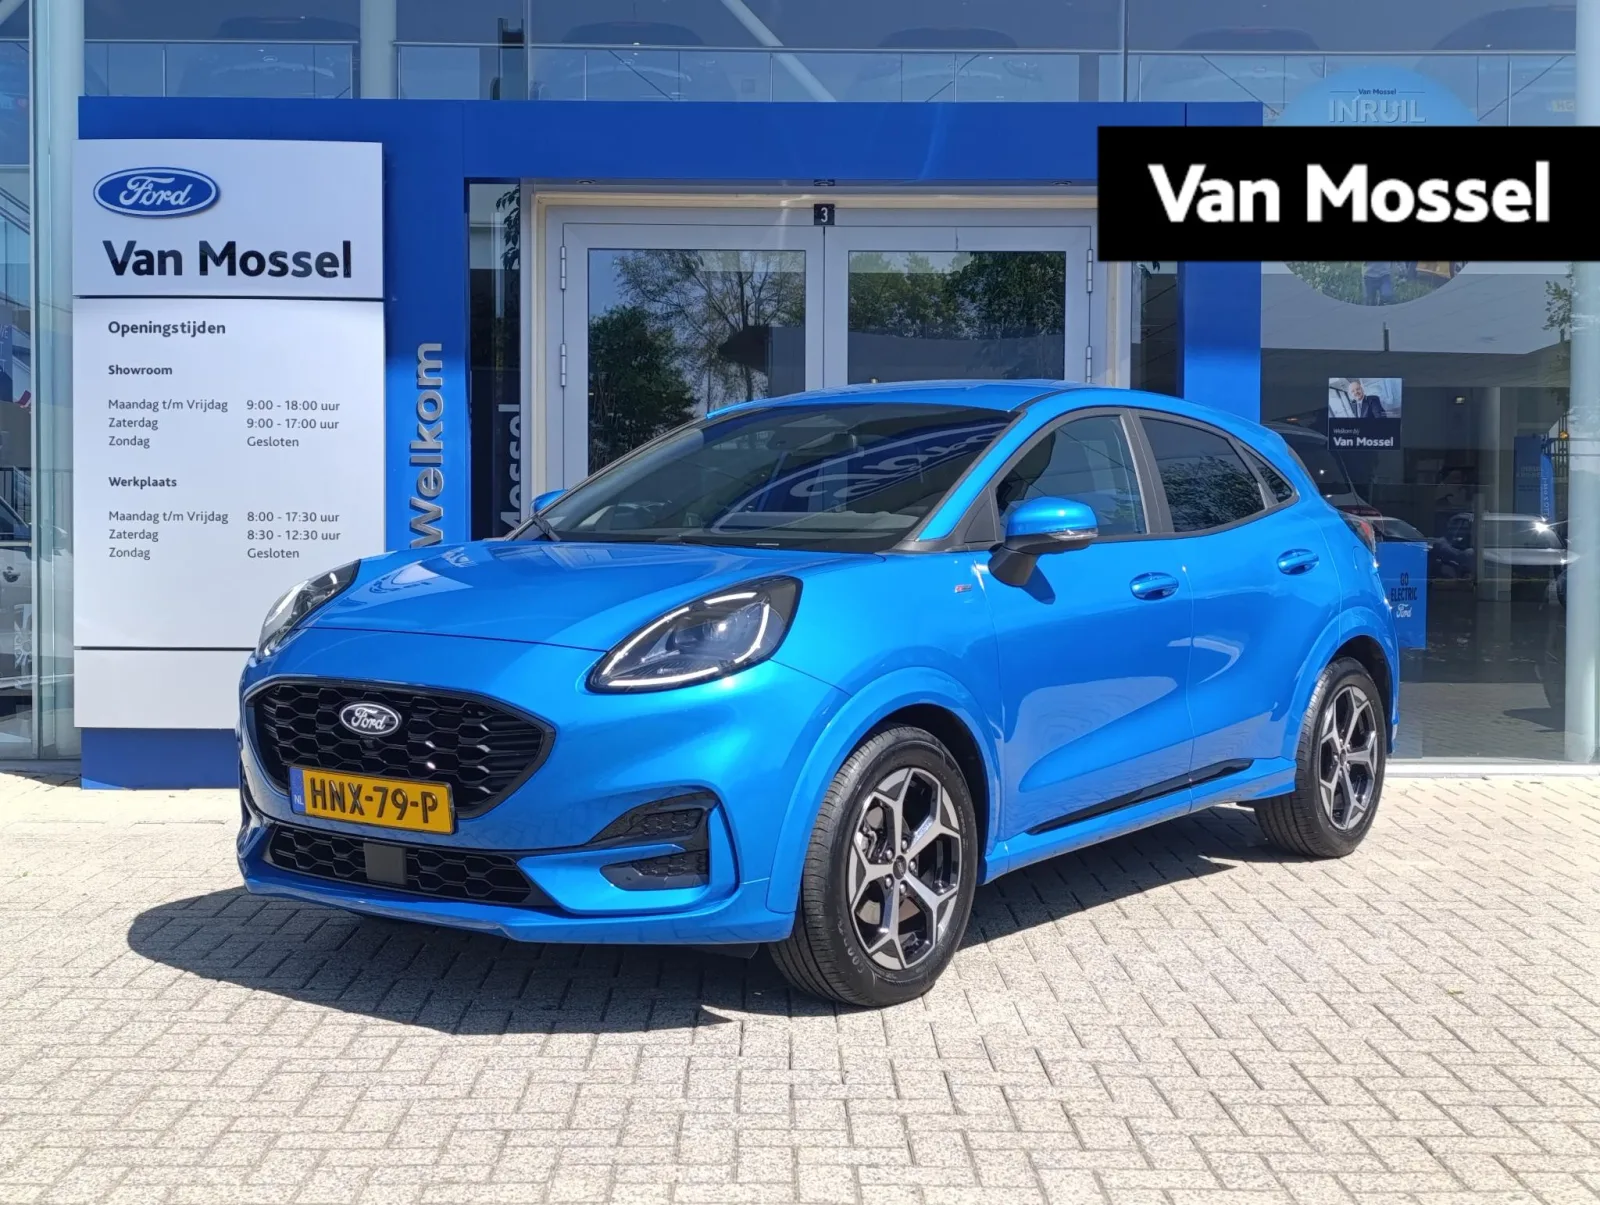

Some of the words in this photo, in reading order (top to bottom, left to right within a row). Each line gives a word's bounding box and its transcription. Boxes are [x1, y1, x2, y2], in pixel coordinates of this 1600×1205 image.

[1358, 88, 1371, 96] Van
[1372, 88, 1397, 96] Mossel
[1328, 98, 1427, 123] INRUIL
[119, 176, 192, 207] Ford
[821, 206, 829, 223] 3
[102, 240, 183, 277] Van
[199, 240, 352, 278] Mossel
[108, 321, 226, 336] Openingstijden
[108, 364, 173, 376] Showroom
[108, 399, 160, 413] Maandag
[162, 399, 184, 410] t/m
[187, 399, 229, 413] Vrijdag
[247, 400, 274, 411] 9:00
[285, 400, 318, 411] 18:00
[321, 403, 340, 411] uur
[108, 417, 159, 431] Zaterdag
[247, 418, 274, 429] 9:00
[285, 418, 317, 429] 17:00
[320, 421, 340, 430] uur
[108, 435, 151, 449] Zondag
[247, 436, 300, 447] Gesloten
[410, 342, 443, 546] Welkom
[1333, 437, 1354, 447] Van
[1356, 436, 1394, 447] Mossel
[108, 475, 178, 491] Werkplaats
[108, 511, 160, 525] Maandag
[162, 511, 184, 522] t/m
[187, 511, 229, 525] Vrijdag
[247, 512, 275, 522] 8:00
[286, 512, 318, 522] 17:30
[321, 514, 340, 522] uur
[108, 529, 159, 543] Zaterdag
[247, 530, 274, 541] 8:30
[286, 530, 319, 541] 12:30
[321, 533, 341, 541] uur
[108, 547, 151, 561] Zondag
[247, 548, 300, 559] Gesloten
[1400, 572, 1409, 587] GO
[1390, 587, 1418, 602] ELECTRIC
[1396, 603, 1412, 618] Ford
[350, 707, 387, 731] Ford
[294, 794, 305, 806] NL
[310, 777, 438, 823] HNX-79-P
